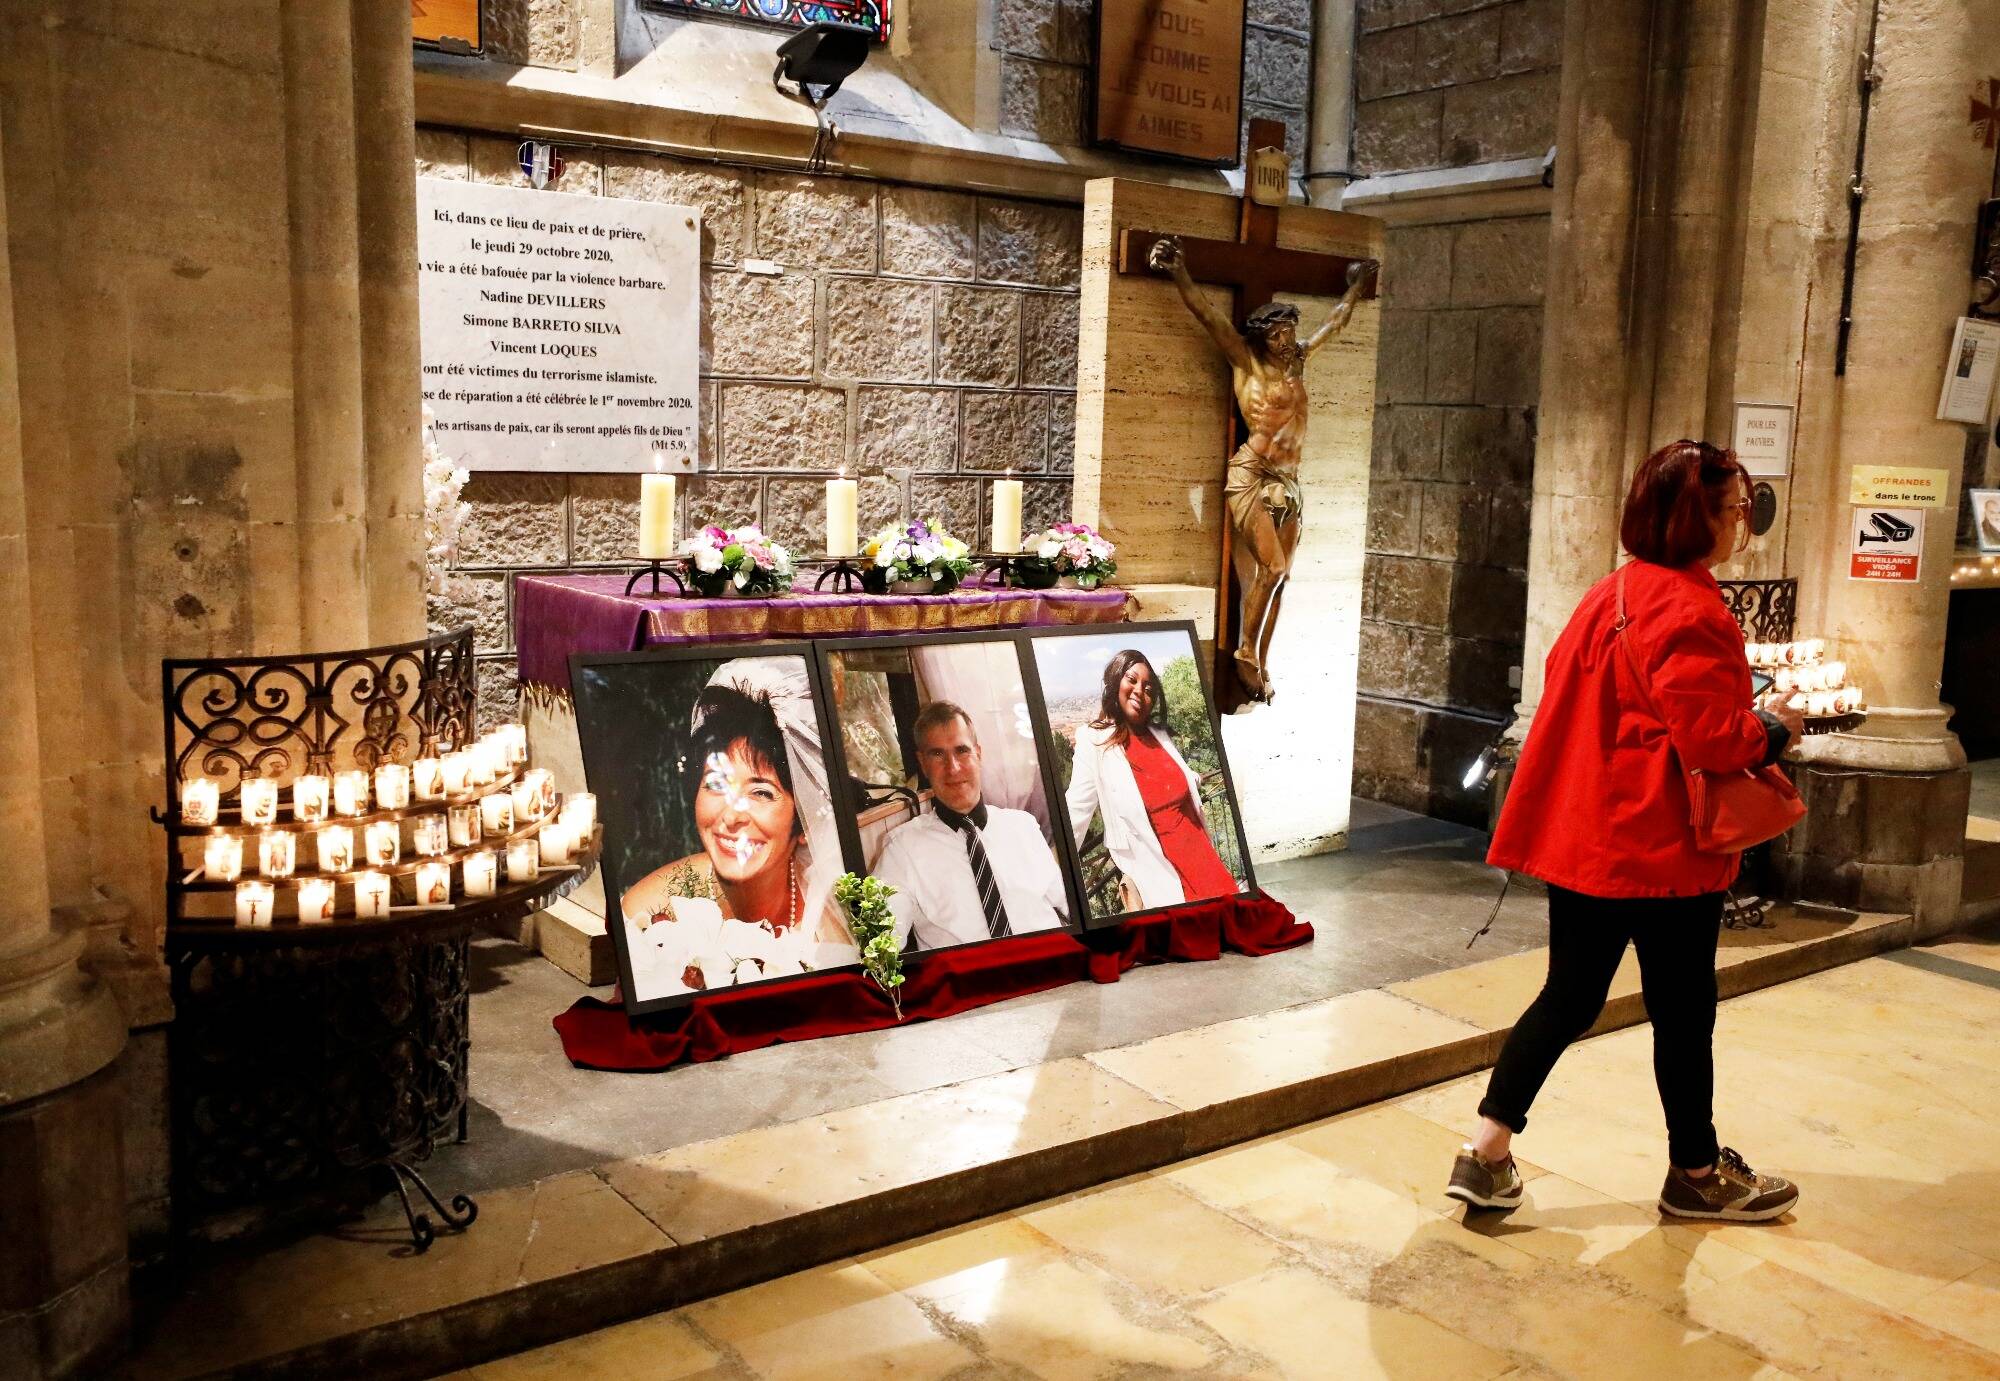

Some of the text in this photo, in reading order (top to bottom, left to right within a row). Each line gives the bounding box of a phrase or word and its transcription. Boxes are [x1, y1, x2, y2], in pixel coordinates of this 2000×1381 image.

[1147, 80, 1206, 109] VOUS
[1211, 95, 1231, 113] AI
[1258, 165, 1285, 192] INRI
[434, 209, 646, 242] Ici, dans ce lieu de paix et de prière,
[471, 238, 613, 263] le jeudi 29 octobre 2020,
[426, 261, 444, 273] vie
[449, 264, 456, 274] a
[460, 262, 477, 275] été
[481, 265, 528, 280] bafouée
[532, 271, 552, 283] par
[556, 271, 566, 283] la
[570, 272, 616, 286] violence
[619, 276, 666, 290] barbare.
[480, 290, 606, 310] Nadine DEVILLERS
[463, 314, 621, 335] Simone BARRETO SILVA
[491, 340, 597, 358] Vincent LOQUES
[423, 363, 657, 384] ont été victimes du terrorisme islamiste.
[438, 389, 452, 400] de
[455, 389, 513, 404] réparation
[516, 394, 523, 403] a
[526, 392, 541, 404] été
[544, 392, 587, 406] célébrée
[590, 395, 598, 406] le
[602, 395, 614, 406] 1er
[617, 397, 665, 408] novembre
[668, 397, 693, 409] 2020.
[435, 420, 449, 431] les
[451, 421, 492, 432] artisans
[494, 422, 507, 433] de
[508, 422, 533, 435] paix,
[534, 425, 550, 434] car
[553, 423, 564, 434] ils
[566, 425, 595, 435] seront
[597, 424, 632, 438] appelés
[634, 425, 647, 436] fils
[649, 426, 660, 436] de
[662, 426, 683, 436] Dieu
[651, 440, 687, 452] (Mt 5.9)
[1872, 477, 1932, 487] OFFRANDES
[1875, 492, 1936, 502] dans le tronc
[1857, 556, 1912, 565] SURVEILLANCE
[1872, 563, 1896, 571] VIDÉO
